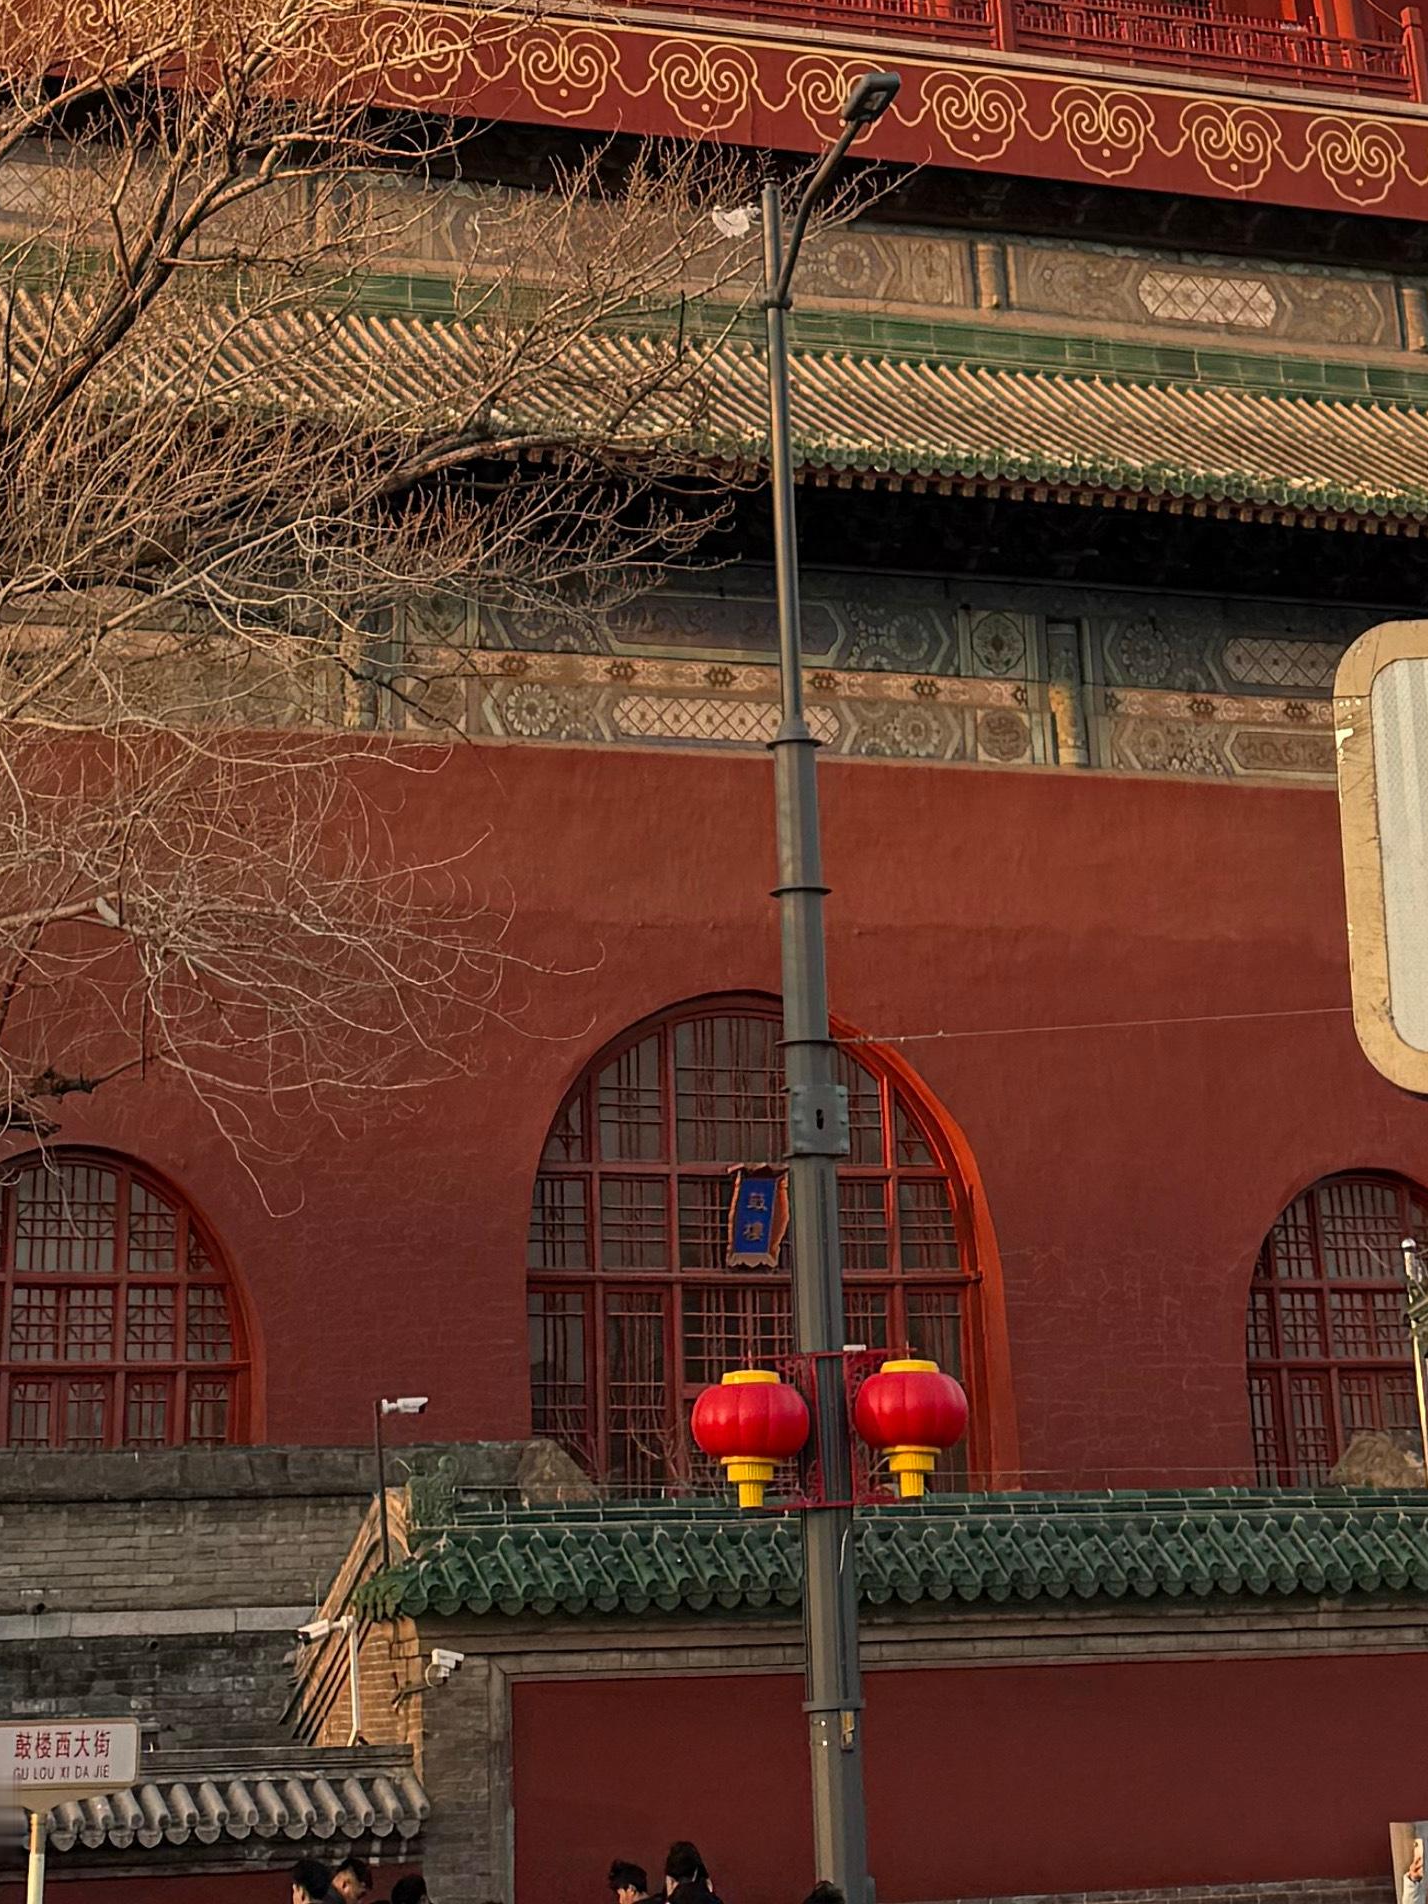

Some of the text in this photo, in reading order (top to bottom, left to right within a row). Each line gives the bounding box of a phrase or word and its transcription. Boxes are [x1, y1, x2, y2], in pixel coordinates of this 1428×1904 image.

[13, 1729, 112, 1760] 鼓楼西大街
[33, 1765, 55, 1780] LOU
[60, 1765, 70, 1778] XI
[75, 1764, 90, 1779] DA
[94, 1764, 110, 1778] JIE
